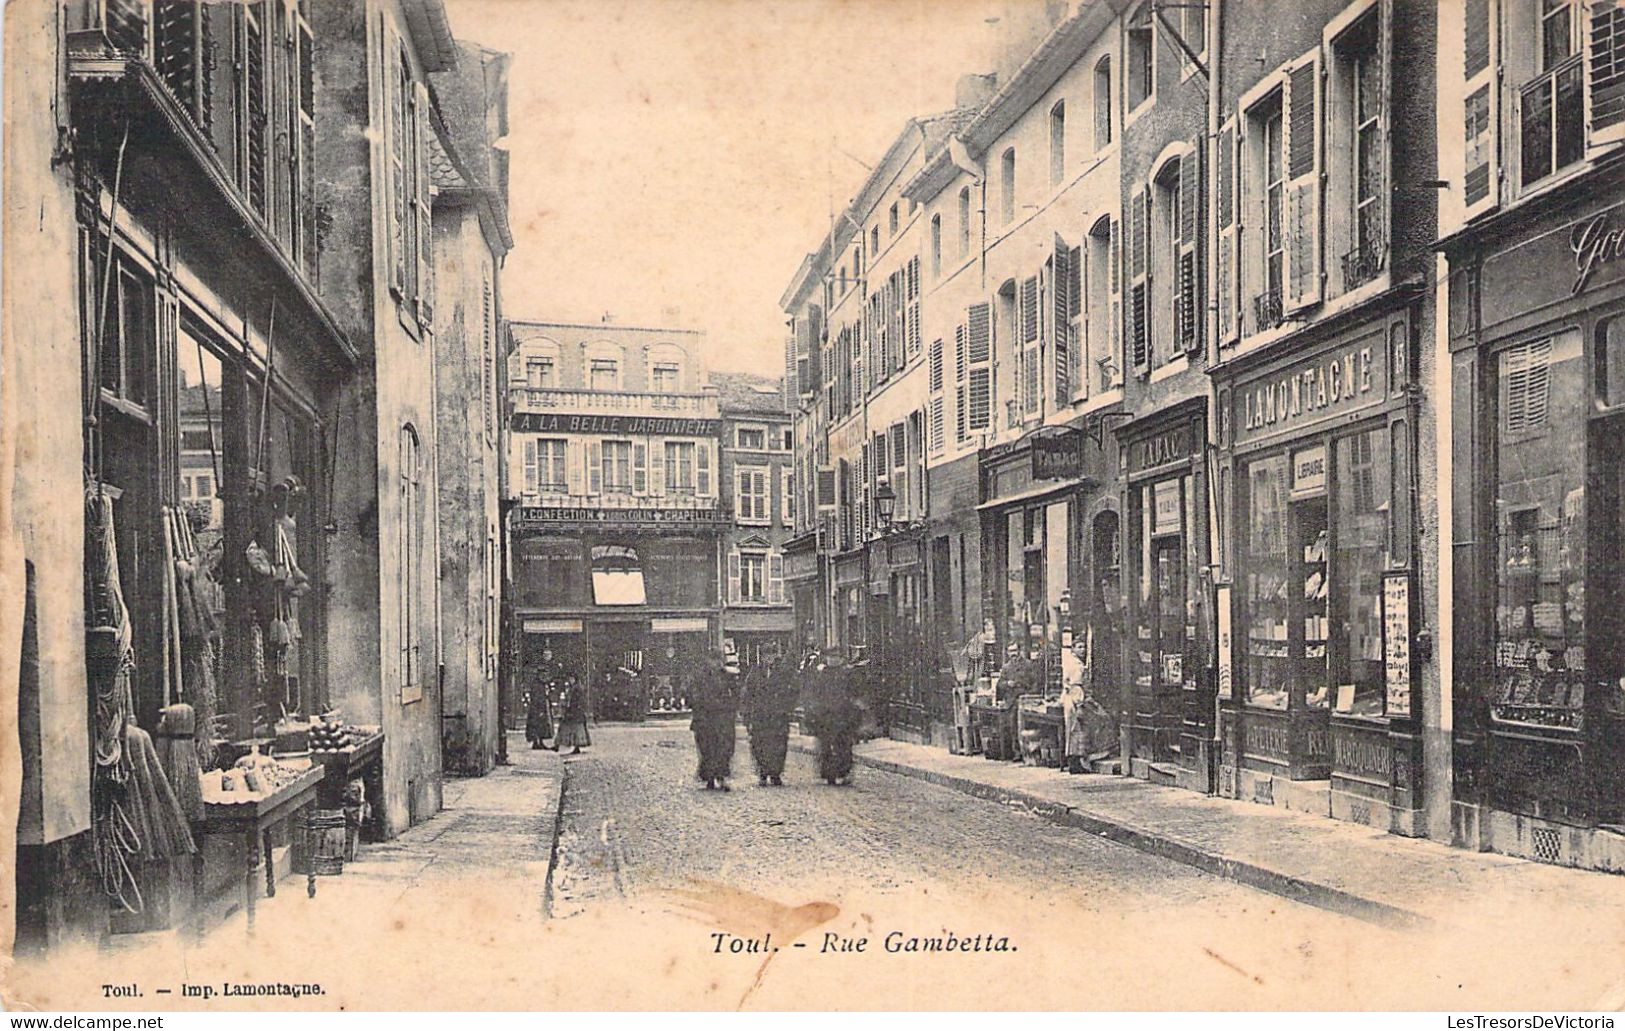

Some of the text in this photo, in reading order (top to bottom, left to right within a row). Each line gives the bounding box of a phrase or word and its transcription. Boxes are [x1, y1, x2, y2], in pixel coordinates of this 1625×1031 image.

[1244, 346, 1373, 430] LAMONTAGNE
[520, 415, 531, 429] A
[539, 415, 558, 431] LA
[570, 416, 620, 432] BELLE
[1140, 433, 1180, 468] TABAC
[529, 509, 594, 521] CONFECTION
[628, 510, 653, 521] COLIN
